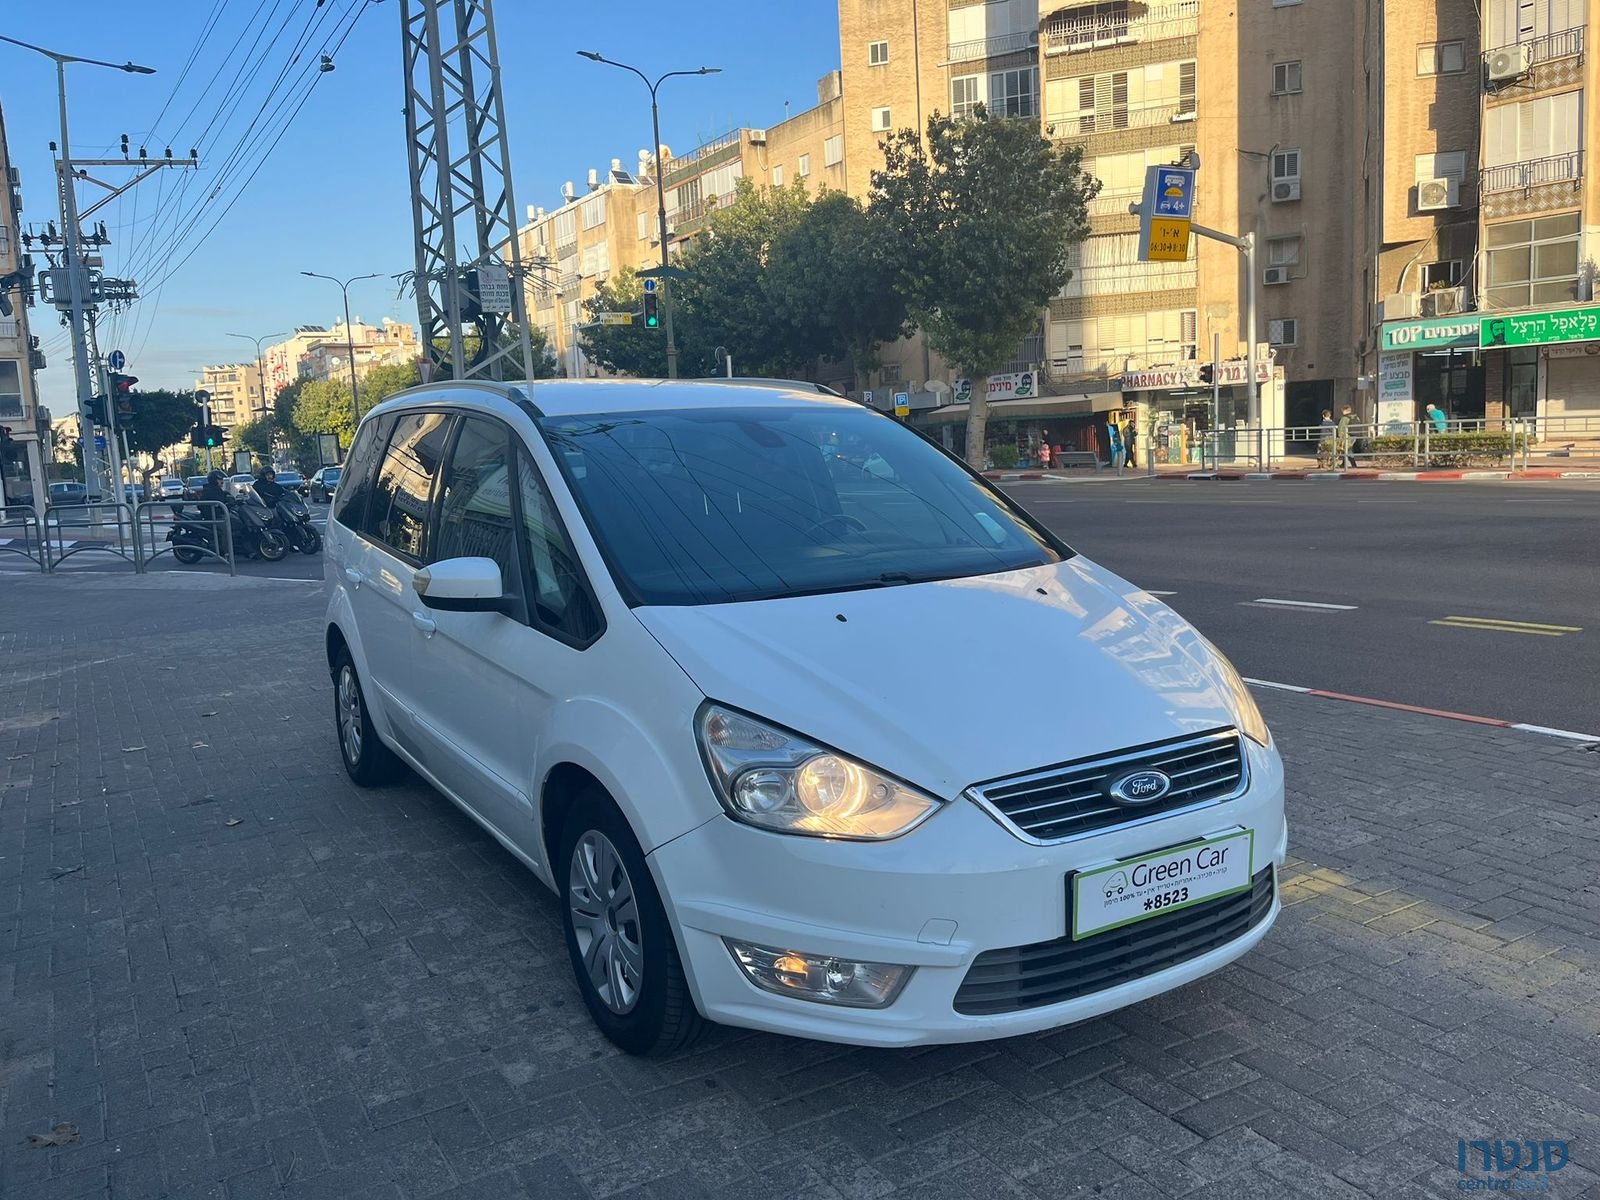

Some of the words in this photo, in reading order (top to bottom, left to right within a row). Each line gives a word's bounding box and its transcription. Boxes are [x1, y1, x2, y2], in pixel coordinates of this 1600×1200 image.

[1387, 325, 1422, 346] TOP
[1120, 371, 1178, 389] PHARMACY
[1132, 778, 1157, 795] Ford
[1132, 857, 1191, 887] Green
[1196, 847, 1229, 870] Car
[1119, 893, 1135, 902] 100%
